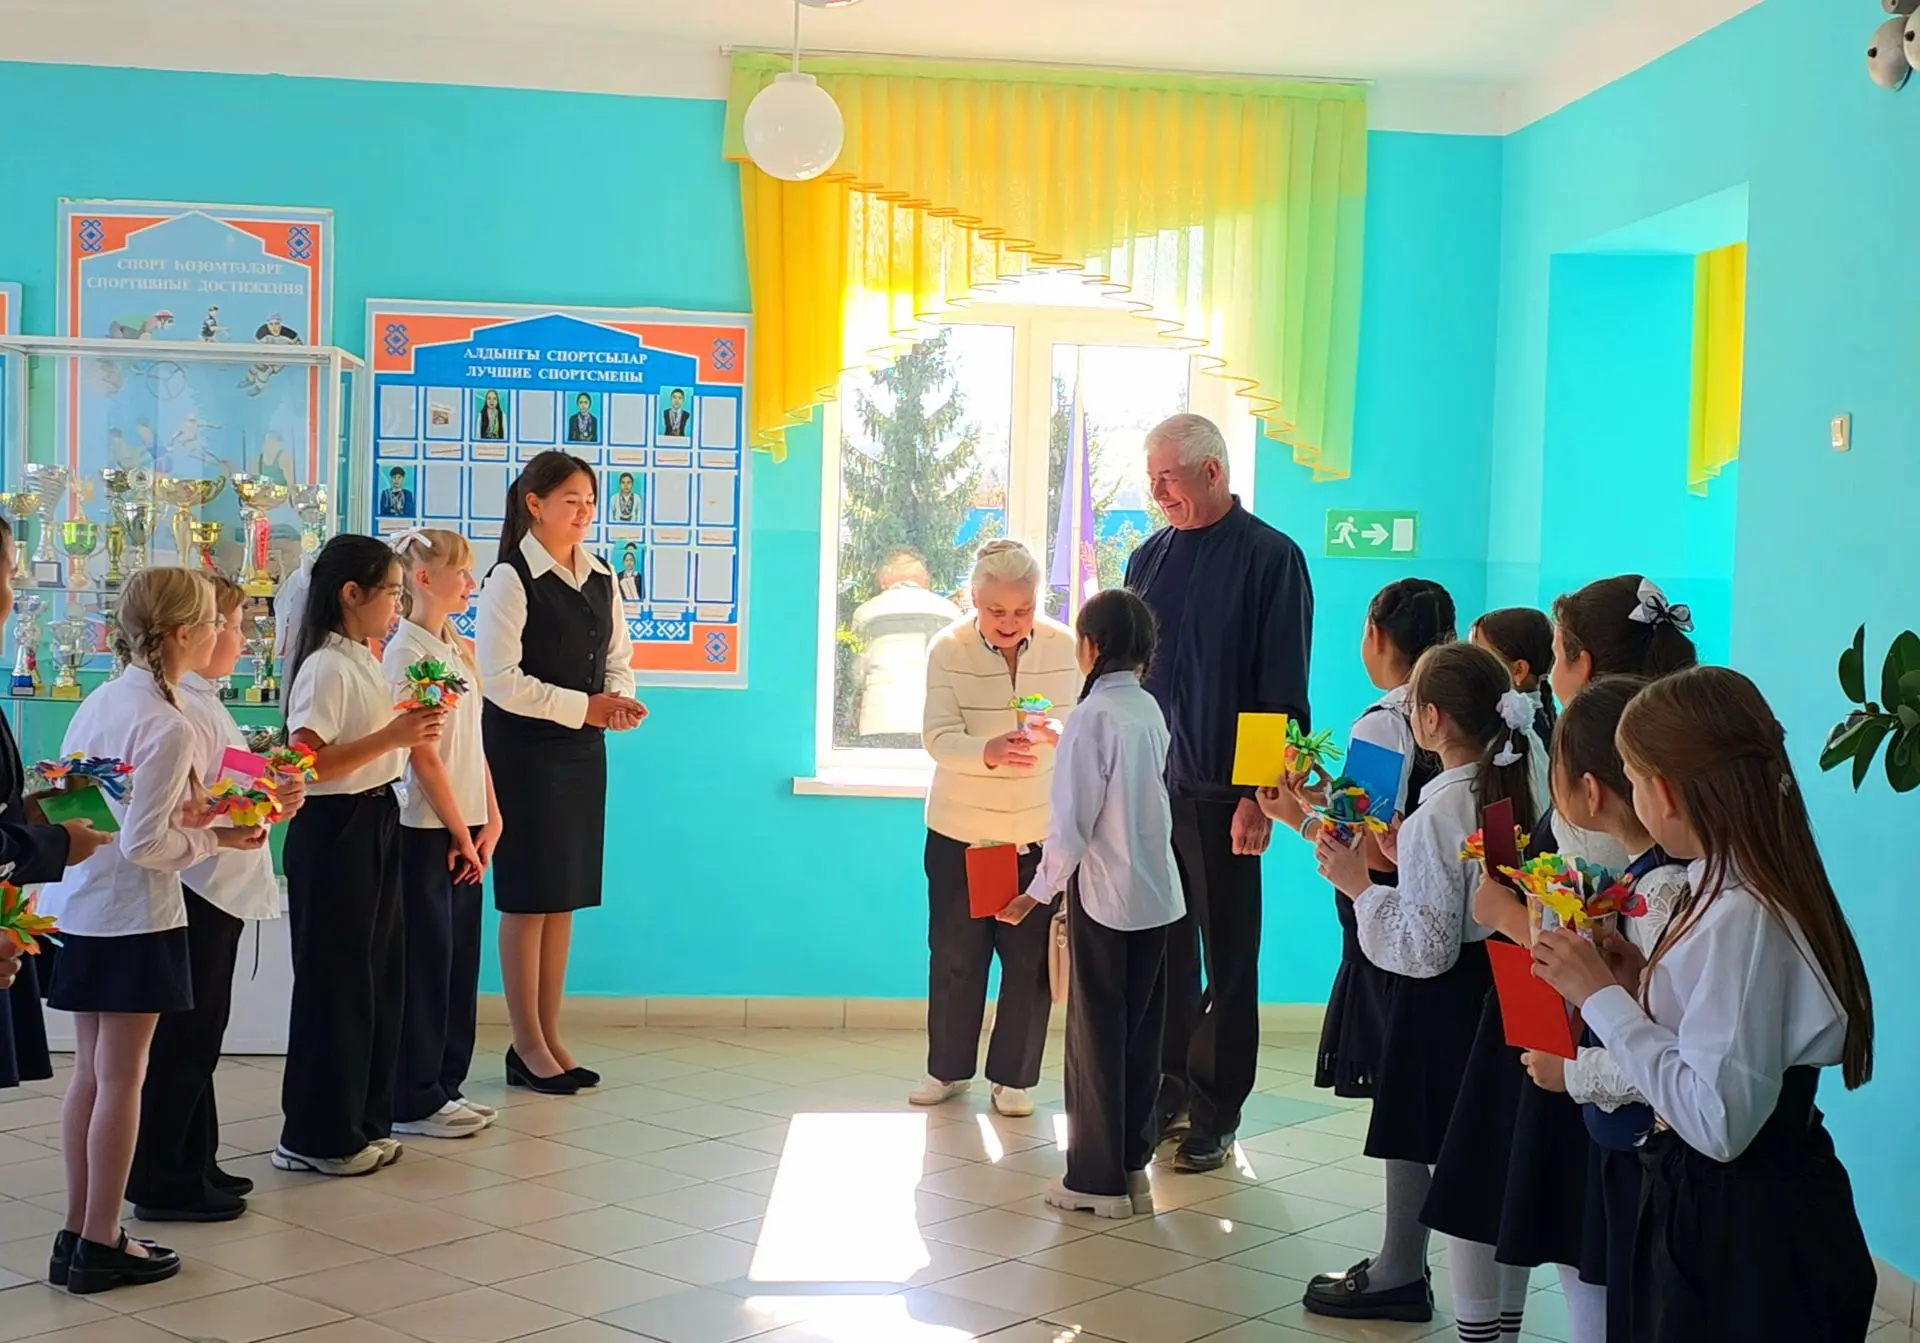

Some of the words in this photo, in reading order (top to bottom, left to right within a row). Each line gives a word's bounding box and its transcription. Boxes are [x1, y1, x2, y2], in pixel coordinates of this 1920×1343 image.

[117, 258, 166, 271] СПОРТ
[87, 276, 190, 291] СПОРТИВНЫЕ
[197, 279, 304, 296] ДОСТИЖЕНИЯ
[546, 350, 647, 365] СПОРТСЫЛАР
[466, 365, 532, 379] ЛУЧШИЕ
[538, 367, 643, 383] СПОРТСМЕНЫ
